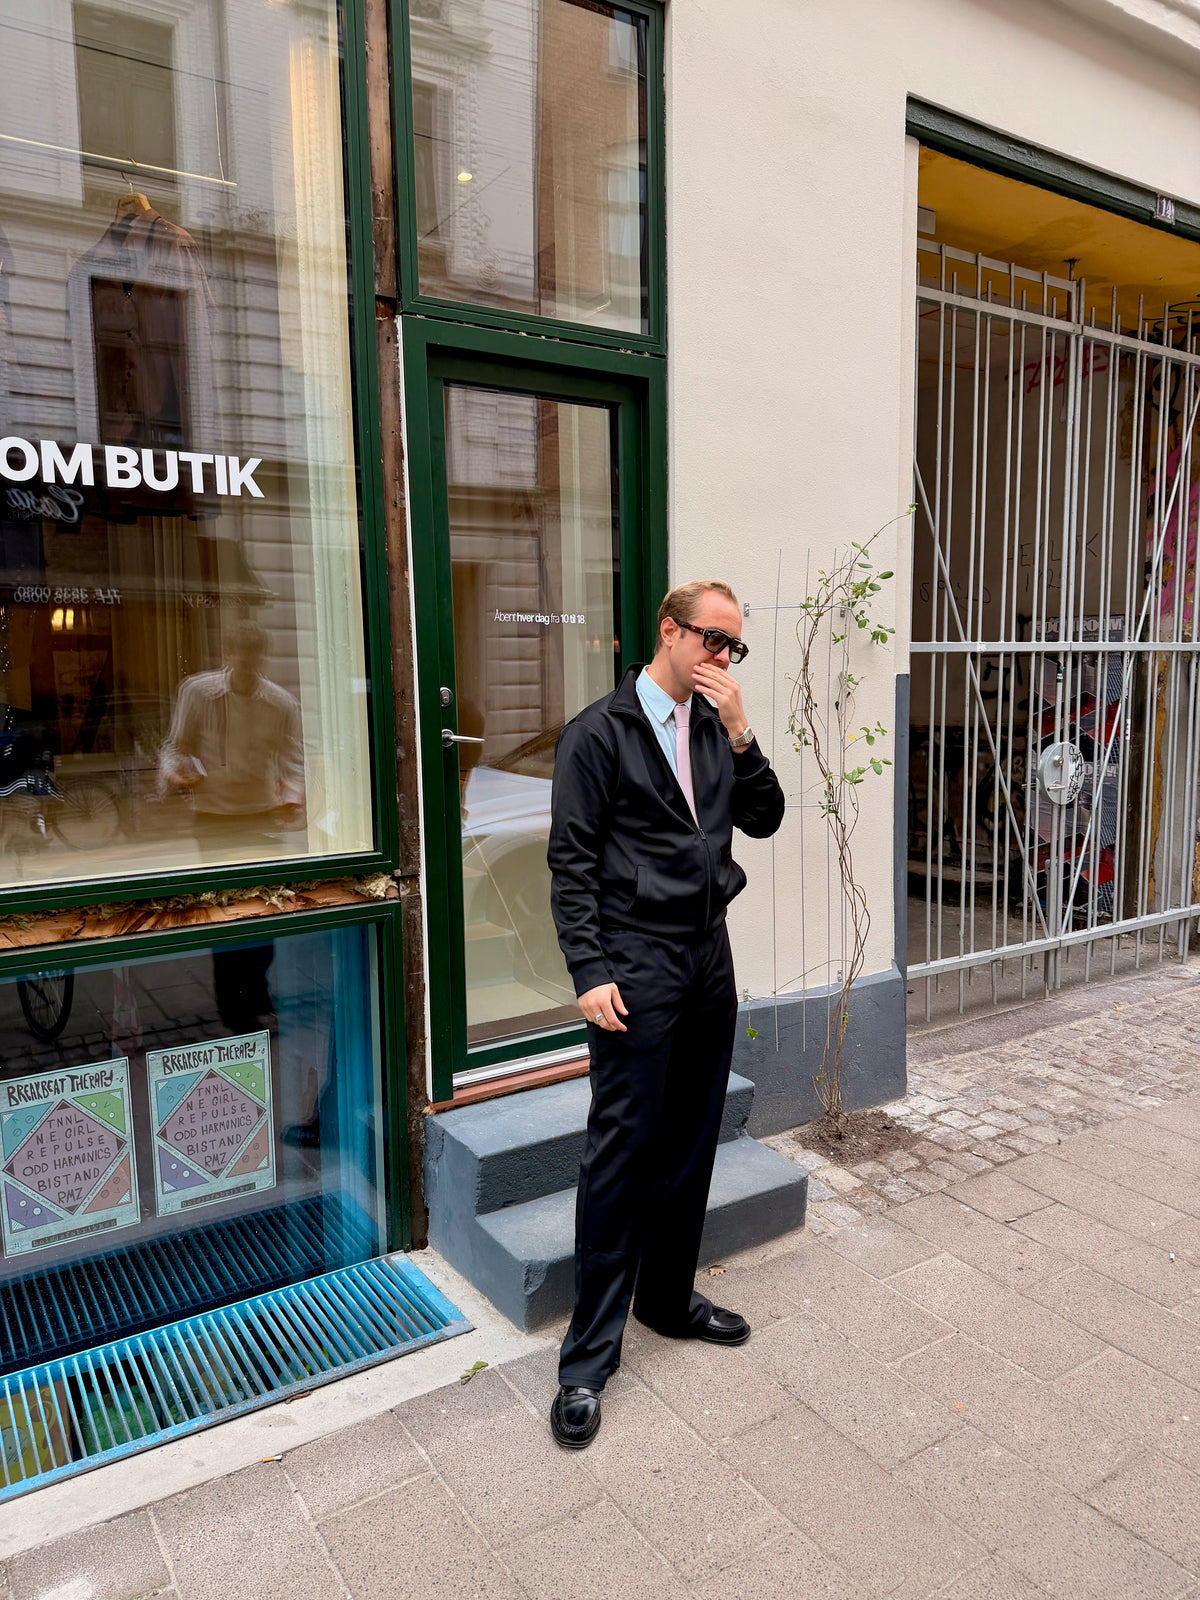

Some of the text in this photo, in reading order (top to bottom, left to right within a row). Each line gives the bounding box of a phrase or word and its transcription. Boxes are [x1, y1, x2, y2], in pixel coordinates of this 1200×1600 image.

[104, 445, 265, 498] BUTIK
[494, 609, 516, 622] Åbent
[516, 612, 535, 623] hver
[535, 613, 550, 625] dag
[550, 613, 560, 624] fra
[560, 613, 569, 624] 10
[162, 1042, 256, 1075] BREAKBEAT THERAPY
[7, 1070, 113, 1107] BREAKBEAT THERAPY
[197, 1083, 229, 1097] TNNL
[212, 1093, 239, 1107] GIRL
[47, 1113, 84, 1130] TNNL
[178, 1103, 247, 1126] REPULSE
[65, 1122, 95, 1140] GIRL
[174, 1115, 252, 1142] ODD HARMONICS
[27, 1135, 105, 1160] REPULSE
[187, 1133, 242, 1156] BISTAND
[22, 1147, 112, 1177] ODD HARMONICS
[204, 1152, 227, 1168] RMZ
[38, 1167, 101, 1192] BISTAND
[58, 1187, 83, 1204] RMZ
